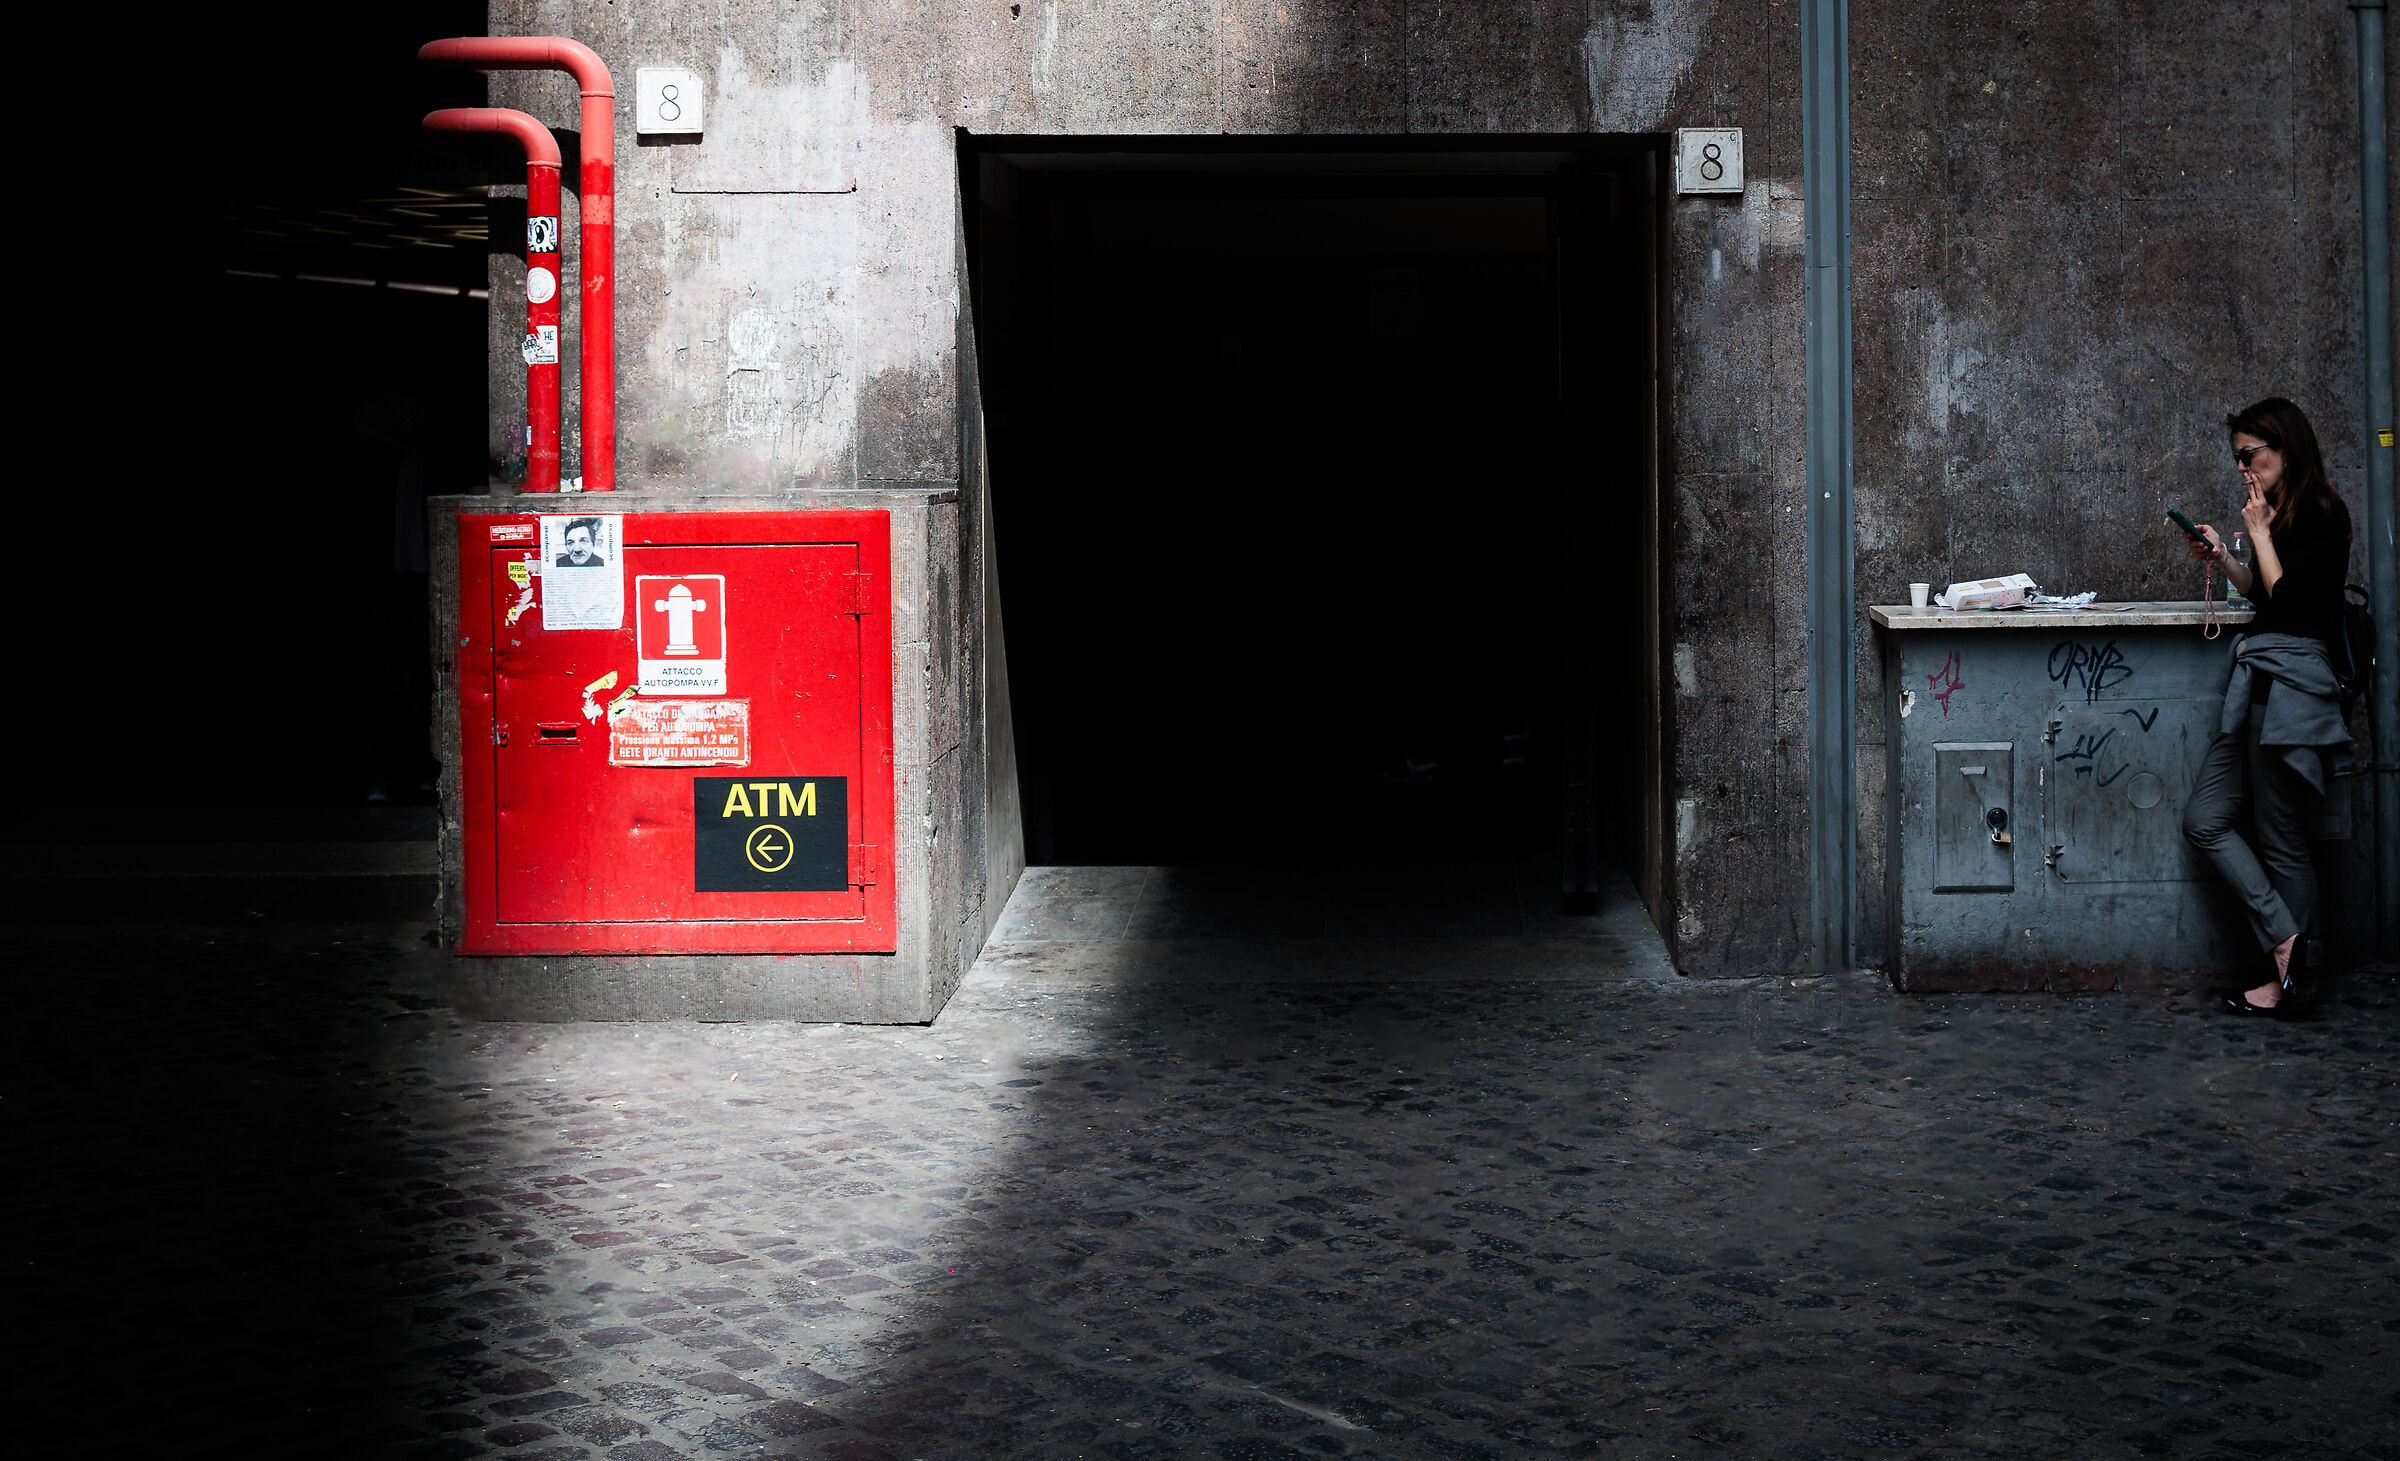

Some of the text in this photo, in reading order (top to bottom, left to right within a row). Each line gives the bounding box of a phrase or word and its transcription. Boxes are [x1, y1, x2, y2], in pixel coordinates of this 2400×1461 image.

[658, 84, 681, 121] 8
[1700, 143, 1723, 180] 8
[661, 667, 703, 676] ATTACCO
[644, 679, 699, 687] AUTOPOMPA
[642, 722, 658, 732] PER
[619, 734, 660, 745] Pressione
[702, 734, 717, 745] 1,2
[619, 747, 739, 758] RETE IDRANTI ANTINCENDIO
[722, 782, 816, 818] ATM
